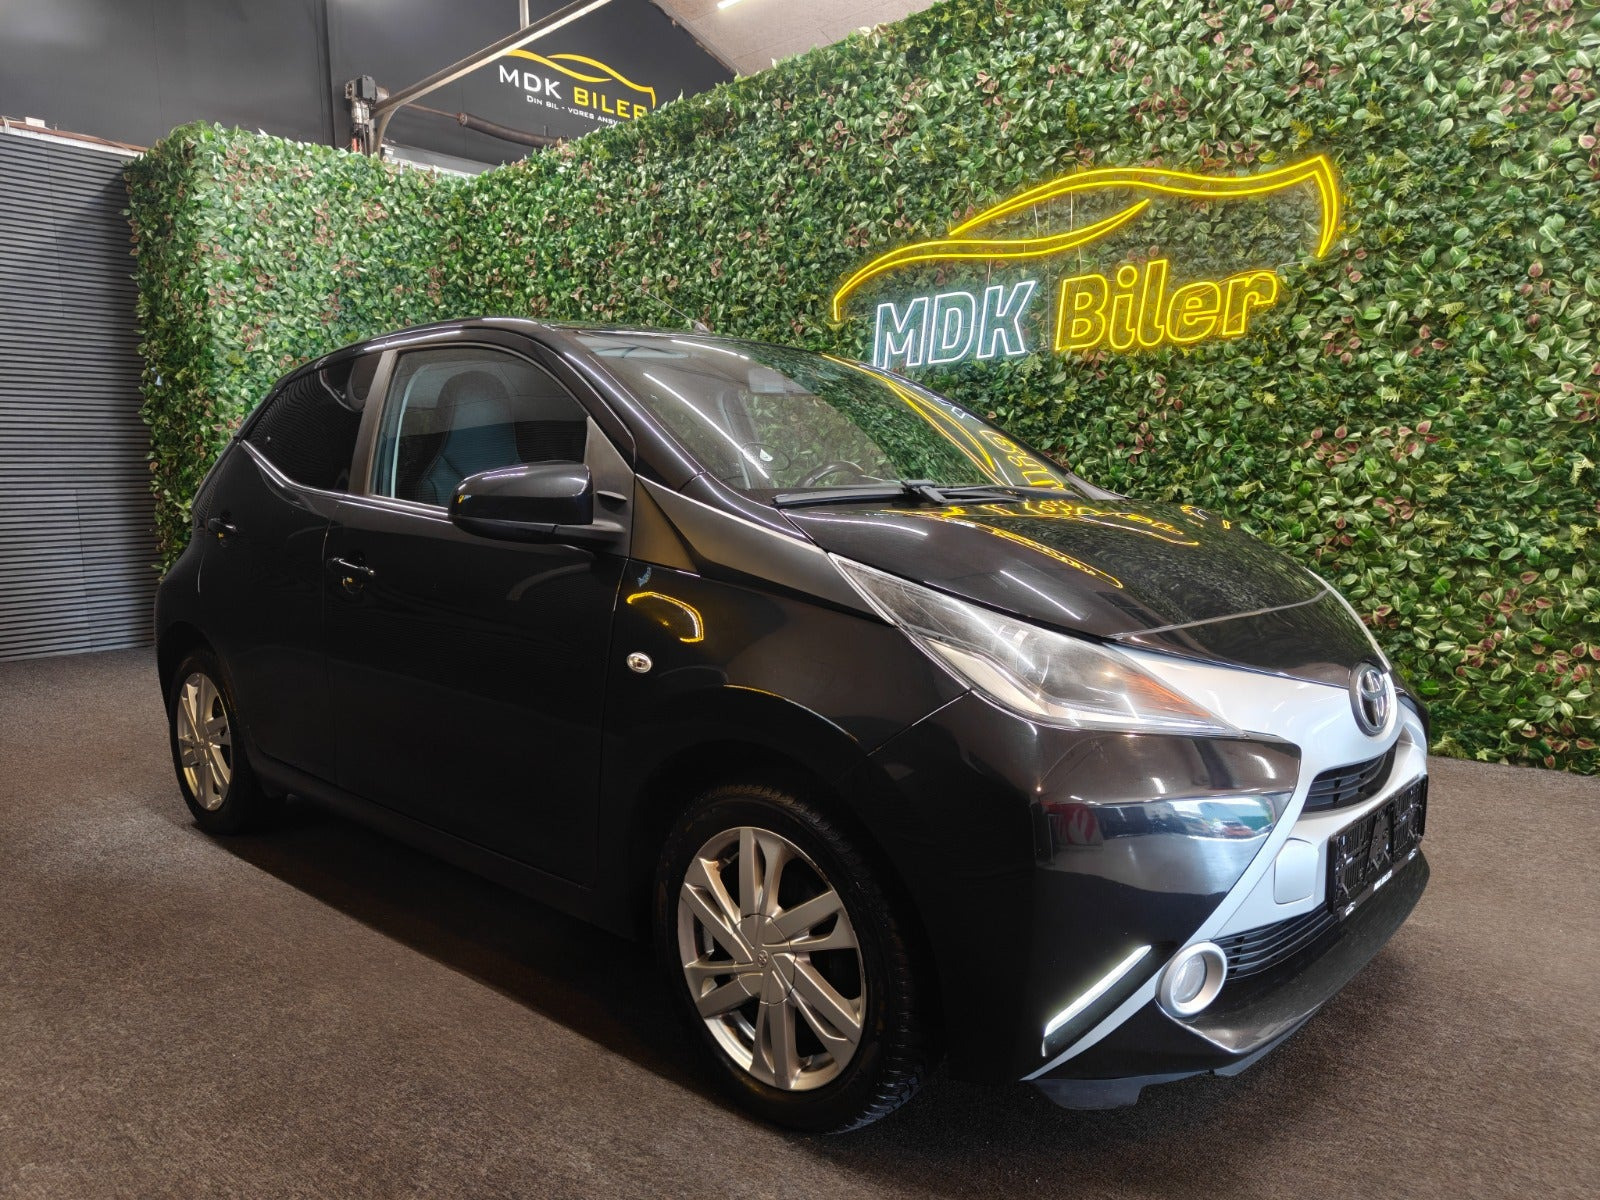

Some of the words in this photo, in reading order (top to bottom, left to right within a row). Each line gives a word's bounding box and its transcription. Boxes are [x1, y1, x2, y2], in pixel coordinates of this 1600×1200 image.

[499, 65, 562, 99] MDK
[526, 95, 543, 105] DIN
[546, 101, 559, 110] BIL
[568, 107, 594, 119] VORES
[597, 115, 618, 125] ANSV
[874, 280, 1038, 370] MDK
[1055, 259, 1280, 351] Biler
